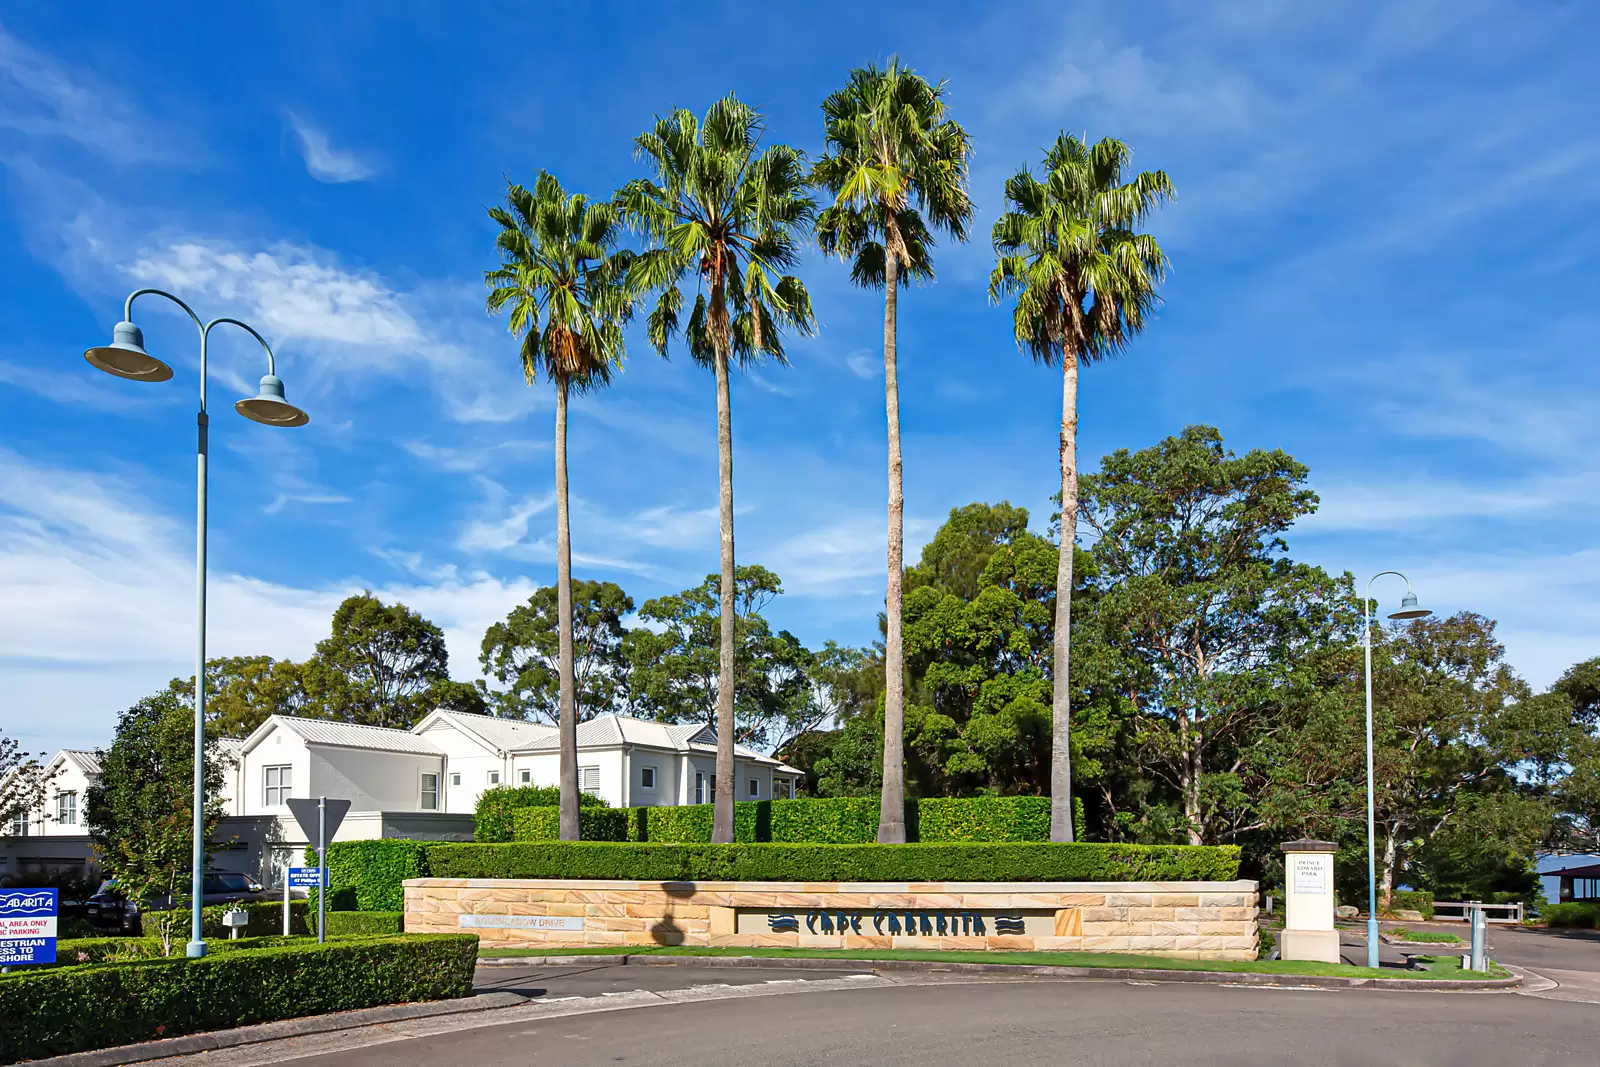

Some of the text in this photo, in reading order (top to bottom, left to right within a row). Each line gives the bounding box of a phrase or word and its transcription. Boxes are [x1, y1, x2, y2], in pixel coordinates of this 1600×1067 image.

[539, 919, 565, 927] DRIVE
[806, 911, 986, 935] CAPE CABARITA
[1, 939, 45, 947] ESTRIAN
